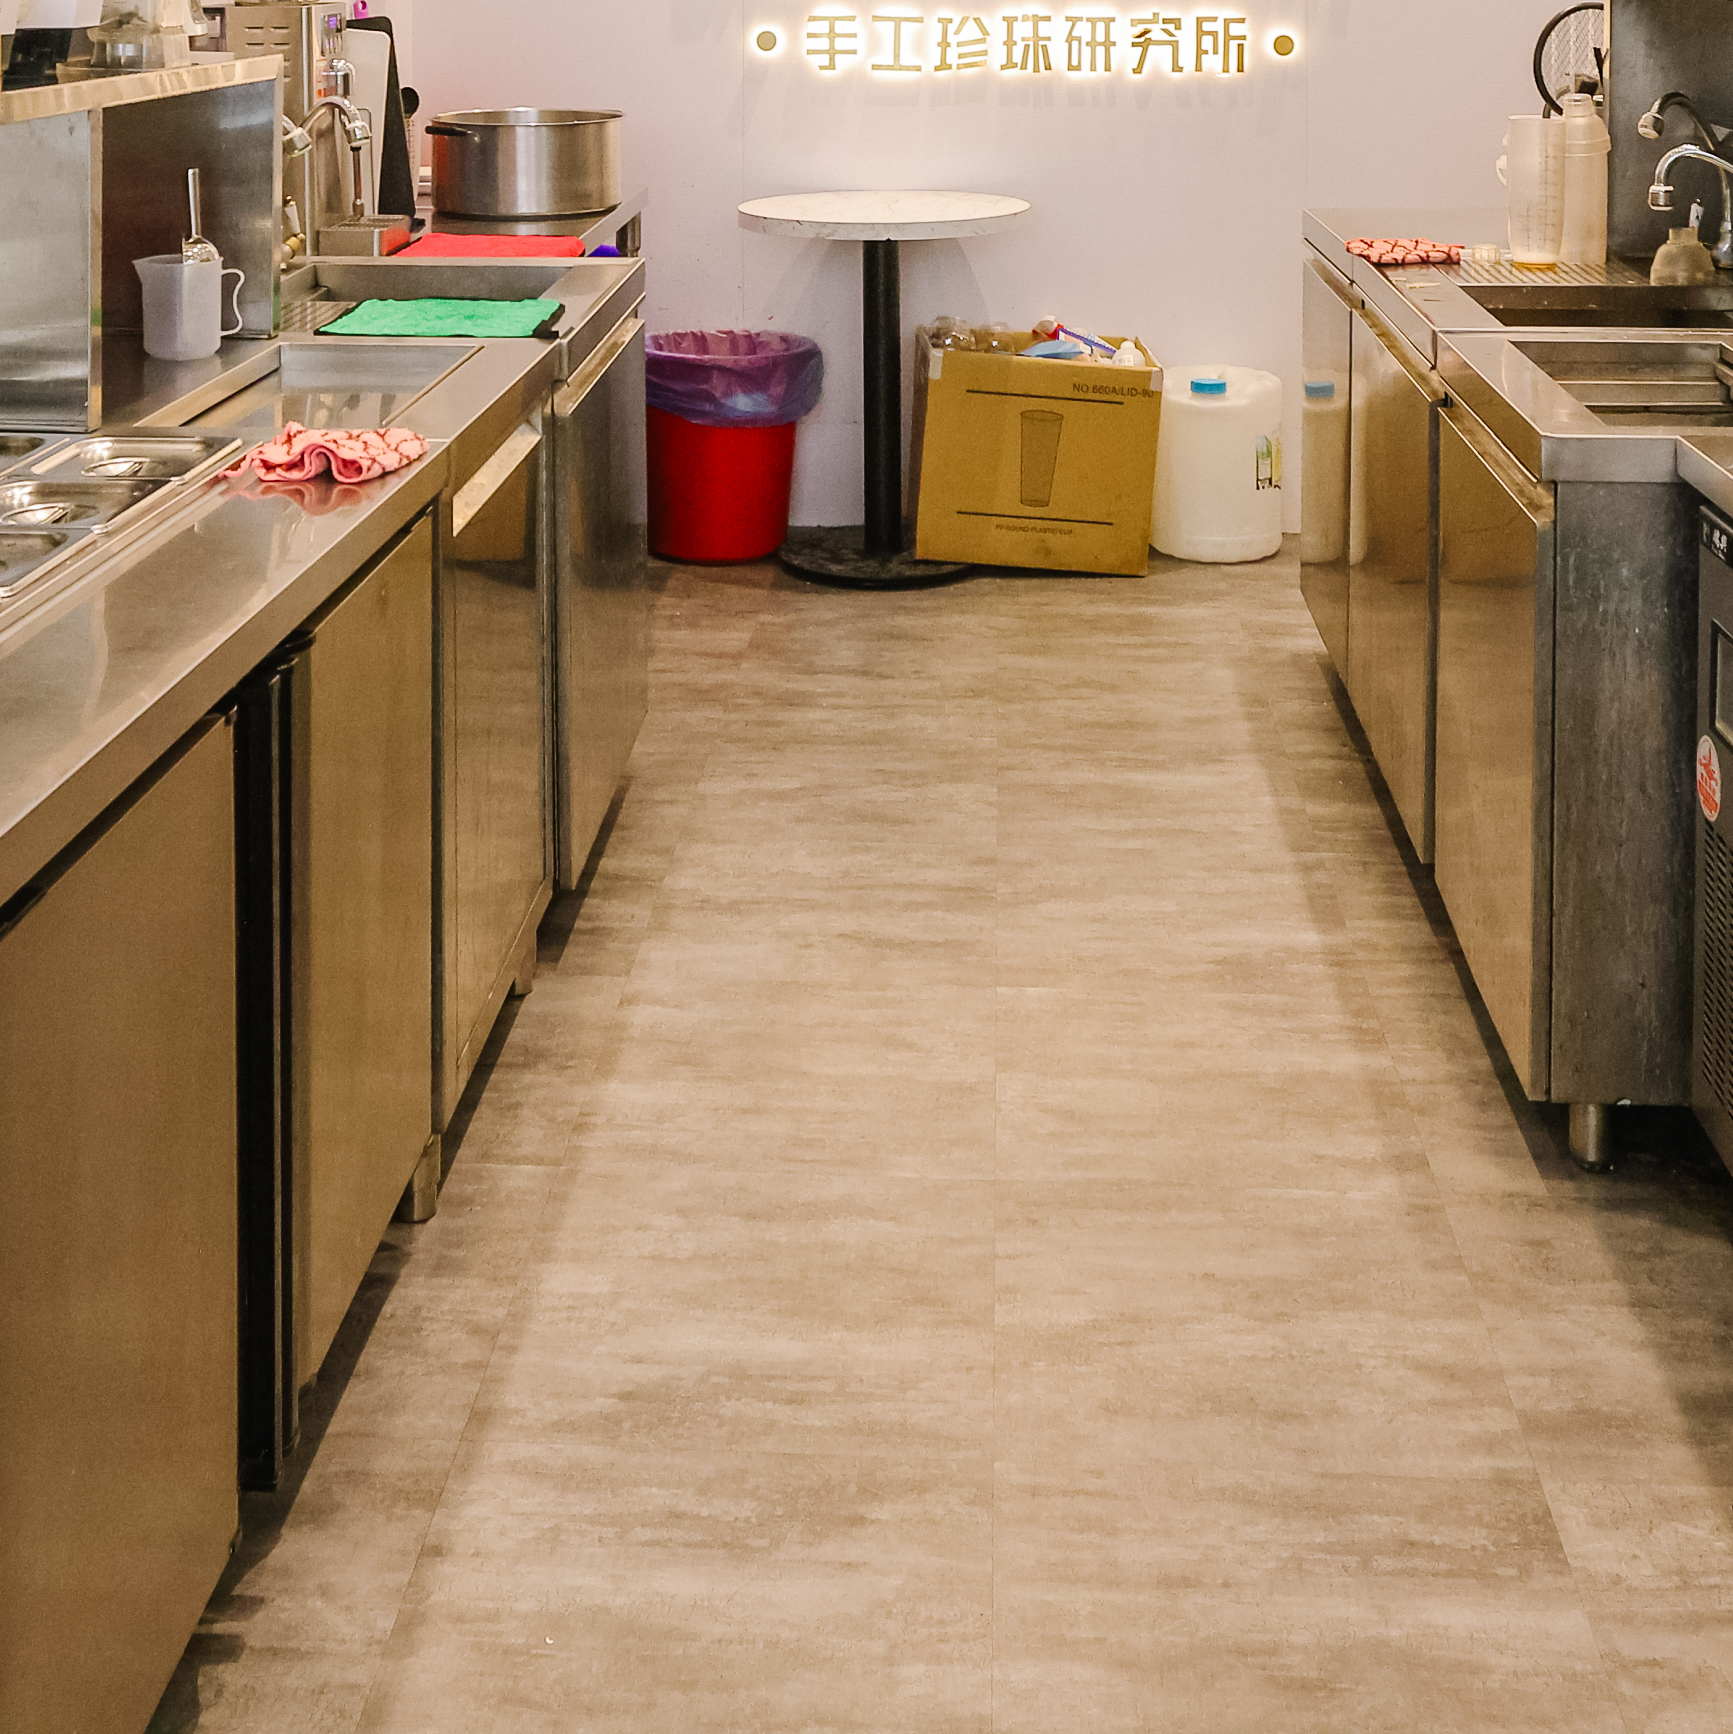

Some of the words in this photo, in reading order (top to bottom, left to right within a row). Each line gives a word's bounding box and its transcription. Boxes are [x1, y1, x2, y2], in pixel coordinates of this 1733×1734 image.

[806, 13, 1248, 75] 手工珍珠研究所
